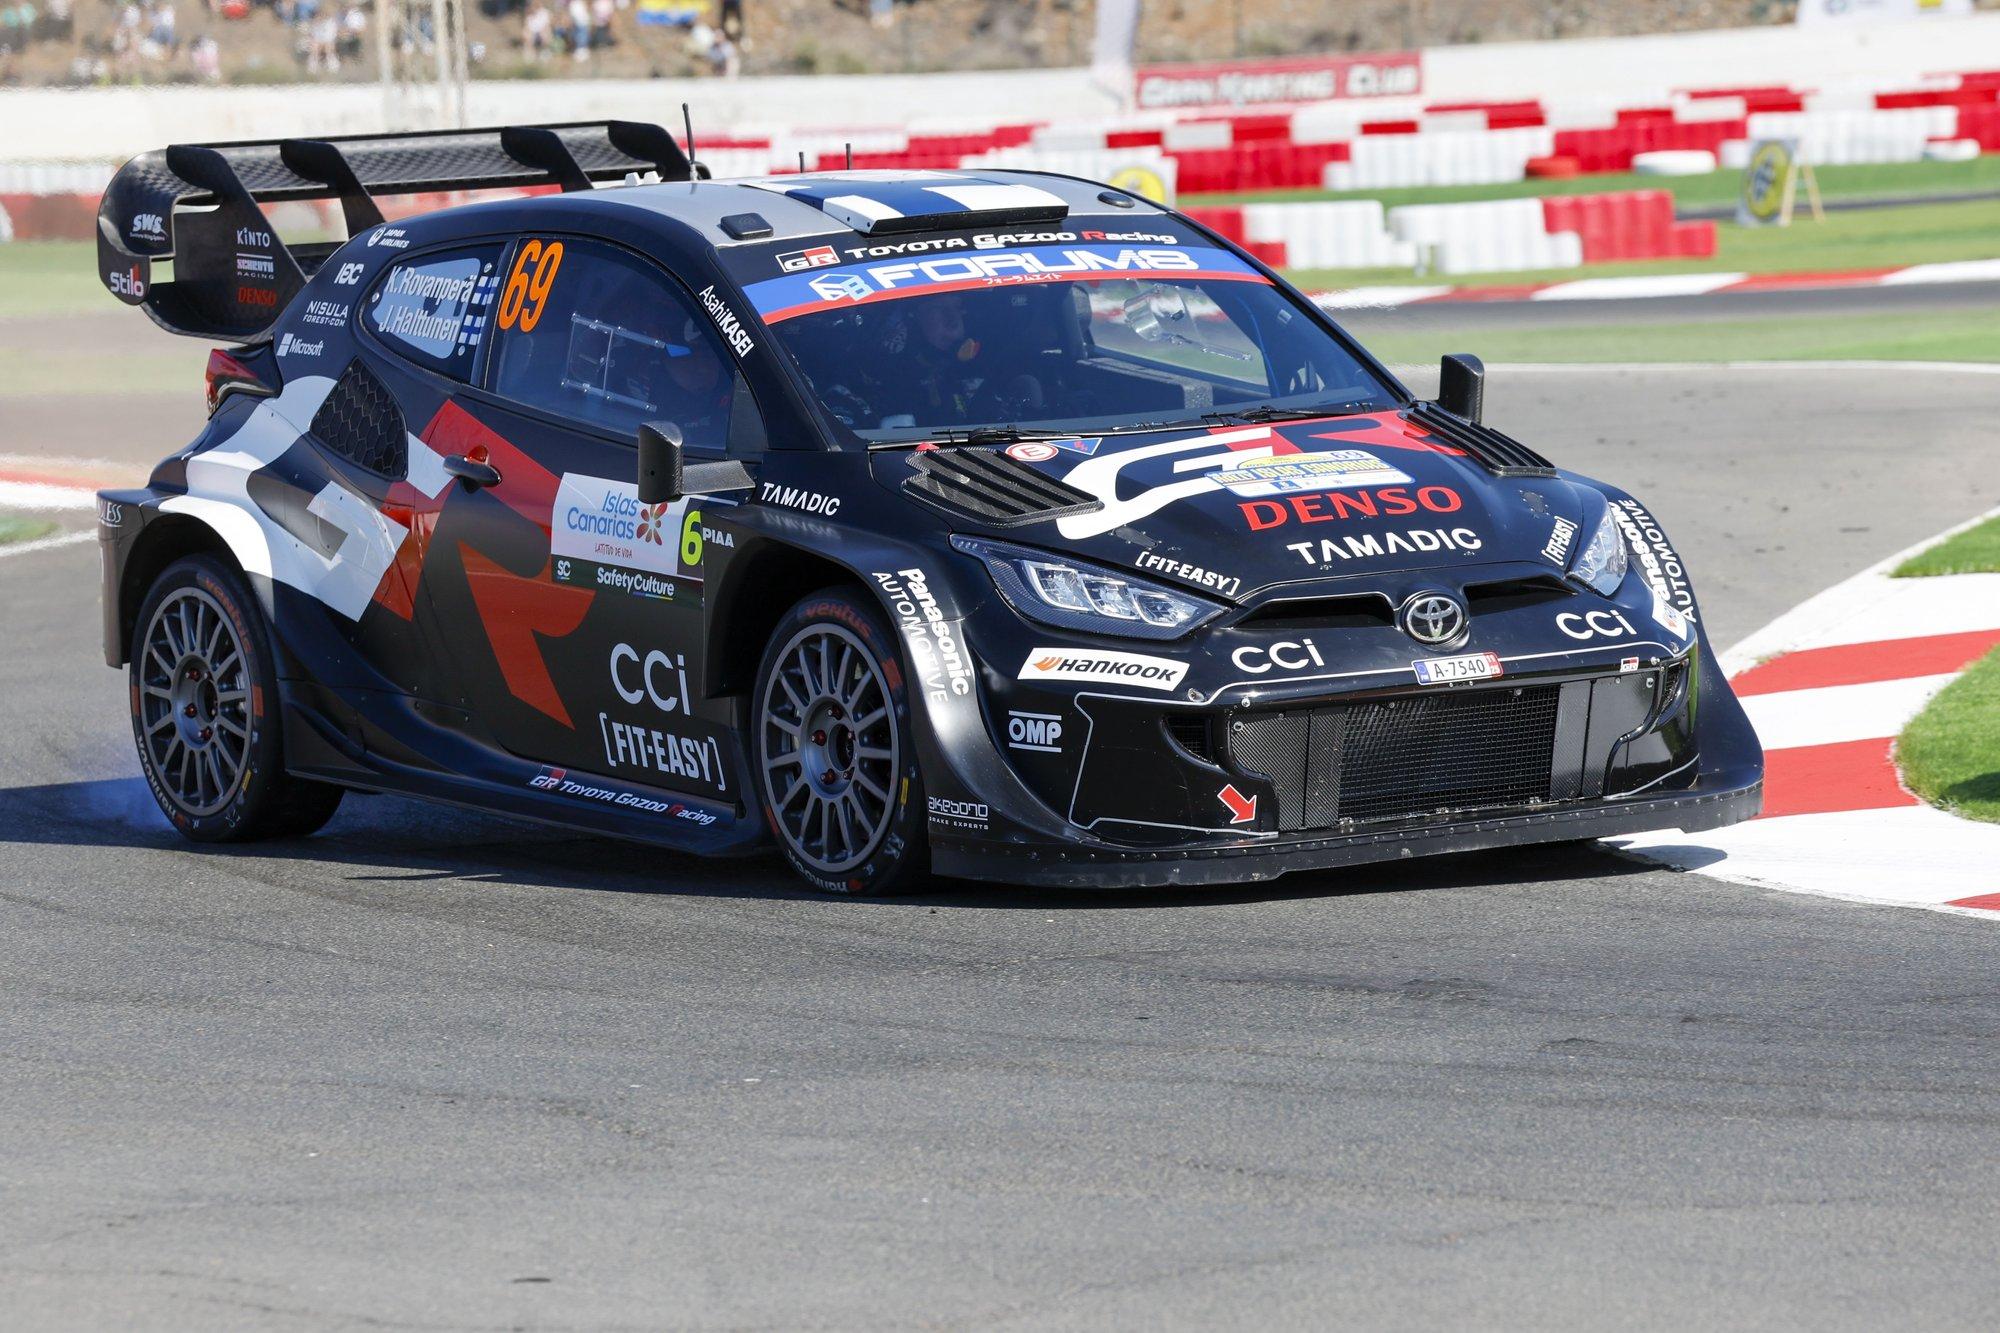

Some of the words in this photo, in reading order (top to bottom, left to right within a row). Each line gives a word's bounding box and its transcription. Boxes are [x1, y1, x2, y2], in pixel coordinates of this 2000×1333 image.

[132, 214, 164, 234] SWS
[780, 250, 838, 272] GR
[844, 238, 968, 259] TOYOTA
[1081, 231, 1178, 245] Racing
[110, 267, 144, 297] Stilo
[237, 271, 275, 280] RACING
[866, 249, 1199, 289] FORUM8
[237, 286, 277, 307] DENSO
[499, 239, 564, 333] 69
[306, 300, 349, 318] NISULA
[289, 338, 324, 356] Microsoft
[602, 489, 639, 516] Islas
[761, 482, 840, 516] TAMADIC
[1237, 486, 1462, 531] DENSO
[567, 507, 635, 540] Canarias
[702, 527, 735, 549] PIAA
[1286, 527, 1482, 565] TAMADIC
[1618, 499, 1697, 623] AUTOMOTIVE
[557, 559, 572, 577] SC
[597, 566, 675, 596] SafetyCulture
[872, 571, 949, 703] AUTOMOTIVE
[897, 568, 969, 696] Panasonic
[1433, 659, 1486, 679] A-7540
[1009, 716, 1062, 746] OMP
[529, 773, 562, 790] GR
[558, 780, 616, 801] TOYOTA
[668, 804, 717, 826] Racing
[953, 821, 989, 830] EXPERTS
